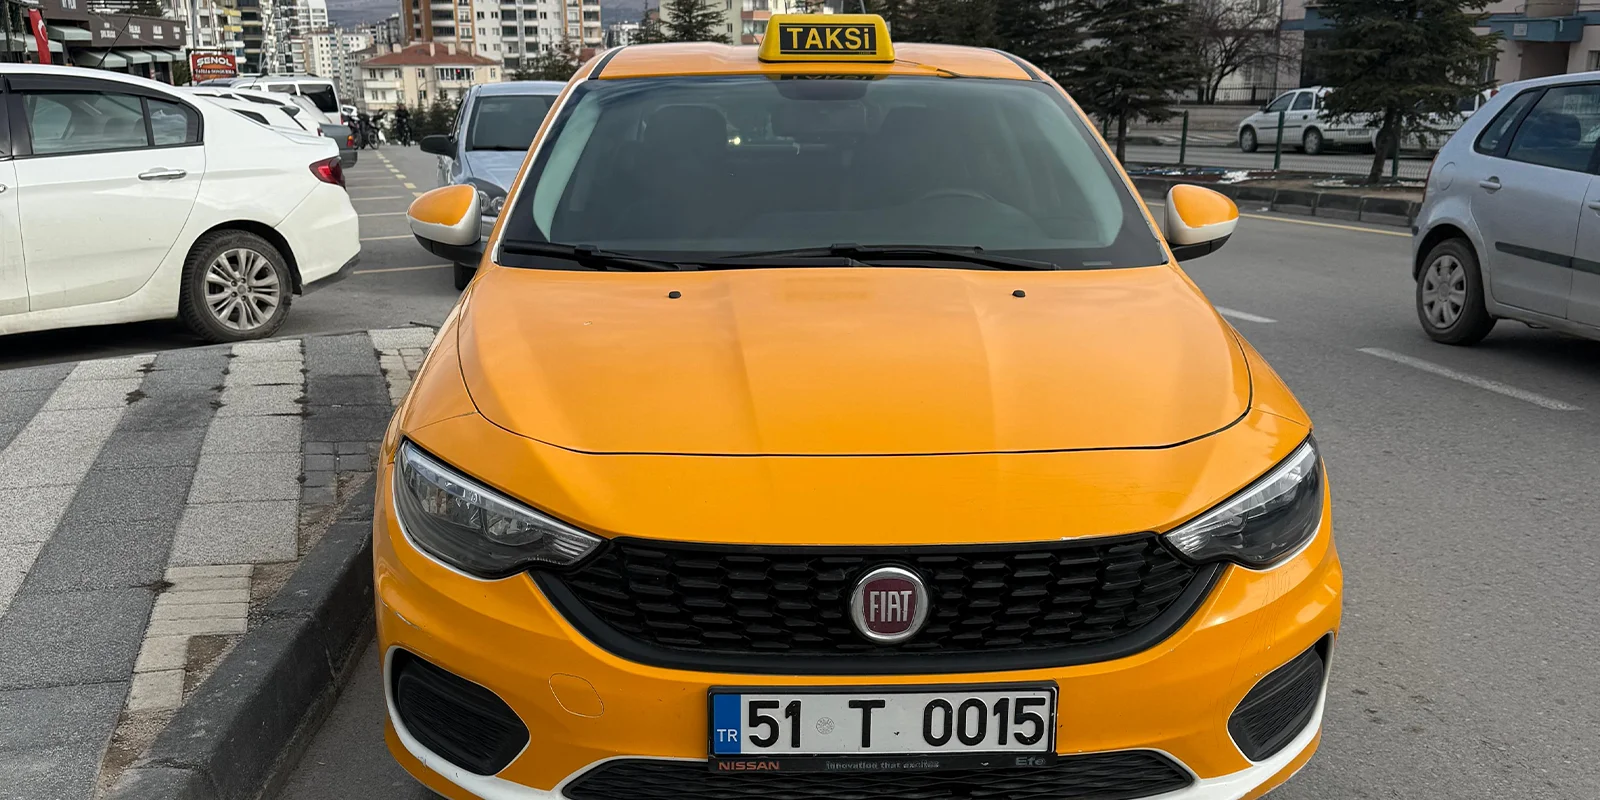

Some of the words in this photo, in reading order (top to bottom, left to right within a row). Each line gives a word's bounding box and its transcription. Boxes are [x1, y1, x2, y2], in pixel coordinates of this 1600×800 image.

[196, 56, 233, 68] ŞENOL
[869, 590, 913, 622] FIAT
[716, 728, 738, 743] TR
[748, 699, 802, 748] 51
[848, 699, 886, 748] T
[922, 697, 1047, 747] 0015
[718, 761, 780, 770] NISSAN
[880, 760, 901, 769] that
